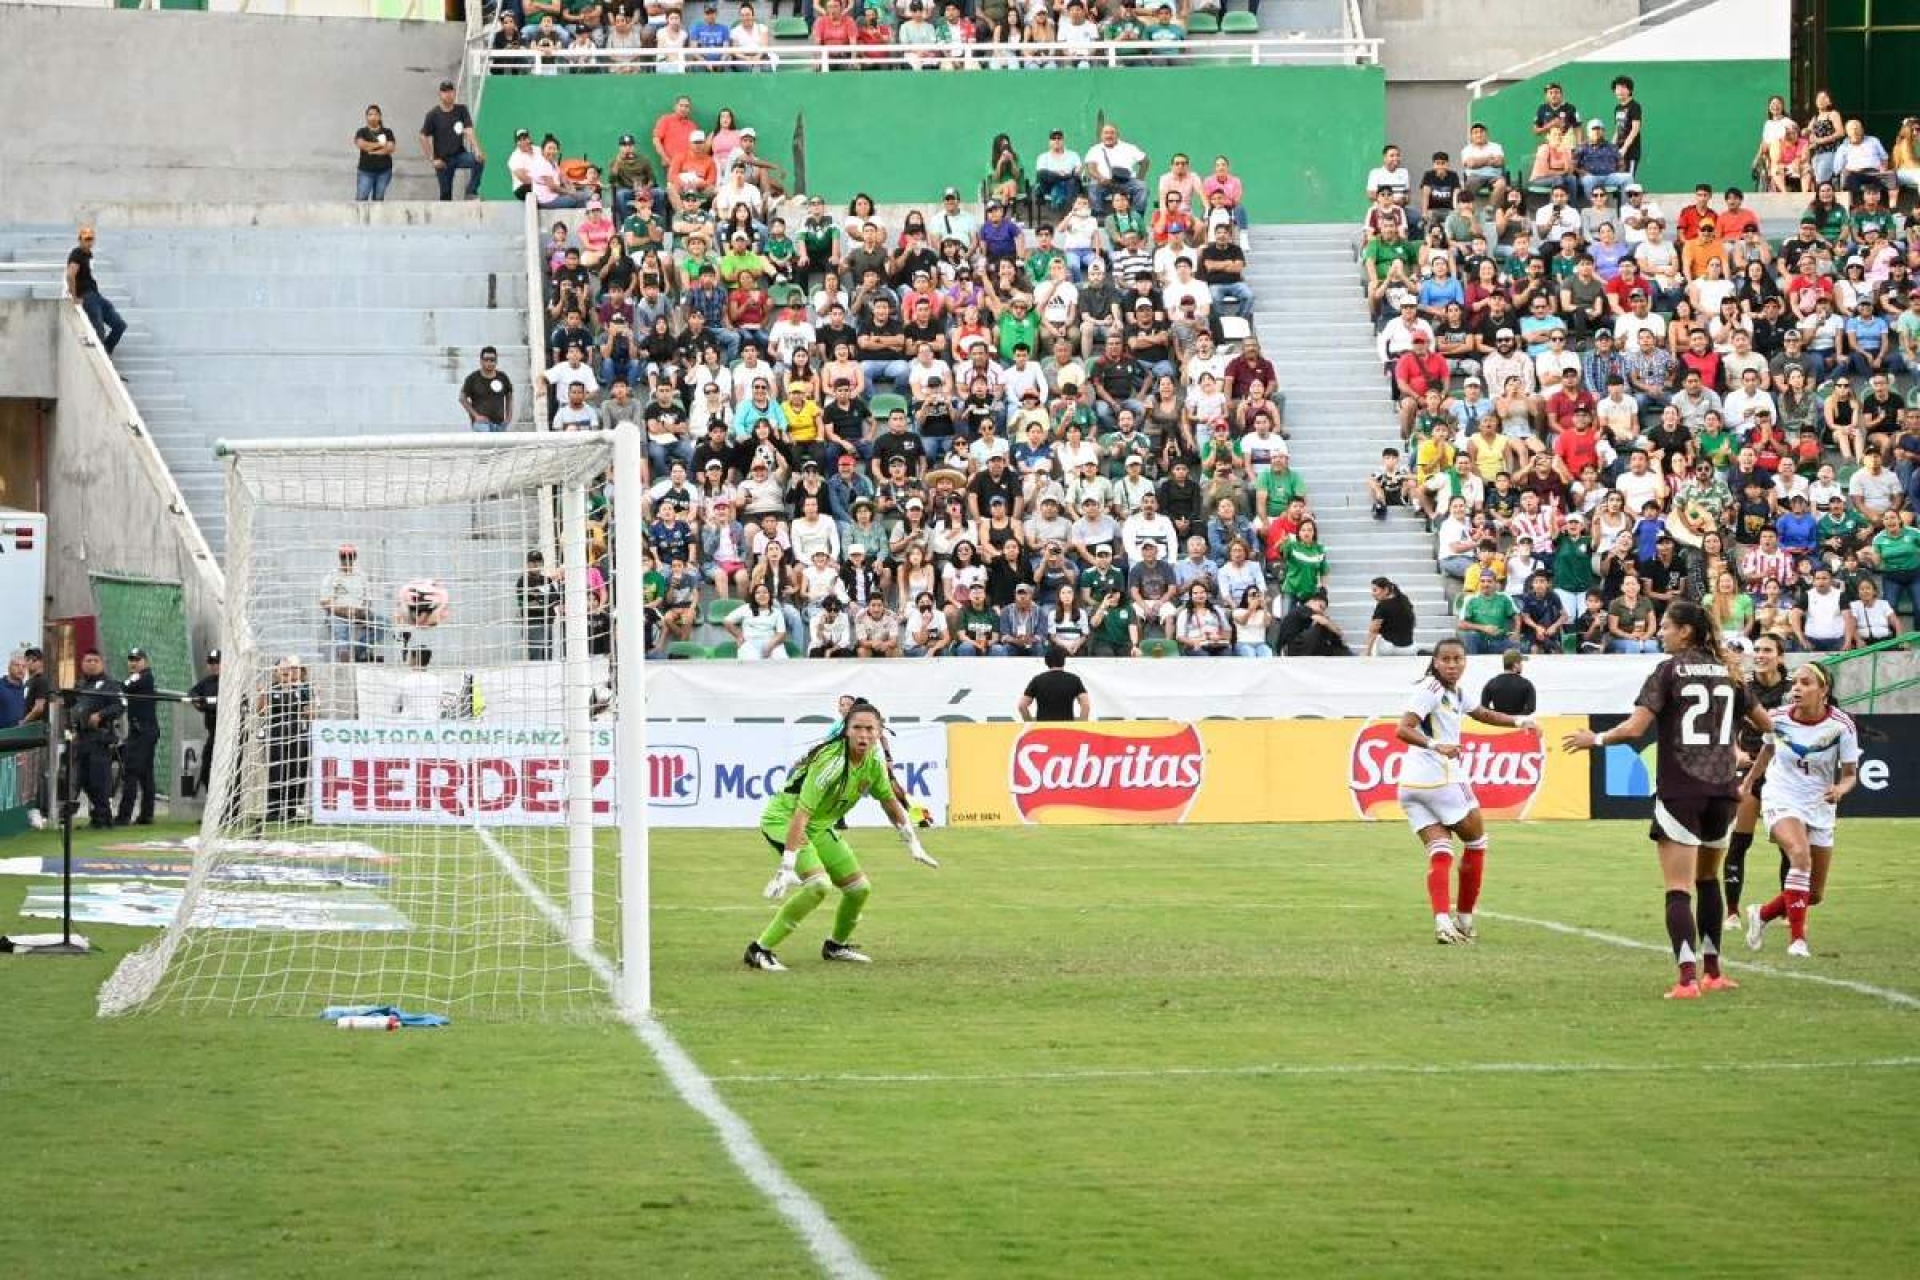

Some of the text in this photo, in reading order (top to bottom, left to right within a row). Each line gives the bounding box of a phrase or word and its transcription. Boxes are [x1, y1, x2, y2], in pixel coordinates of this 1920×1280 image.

[320, 728, 369, 744] CON
[375, 729, 435, 745] TODA
[442, 729, 569, 745] CONFIANZ
[1681, 683, 1734, 745] 27
[1010, 742, 1203, 794] Sabritas
[1350, 739, 1542, 791] Saitas
[1796, 759, 1809, 775] 4
